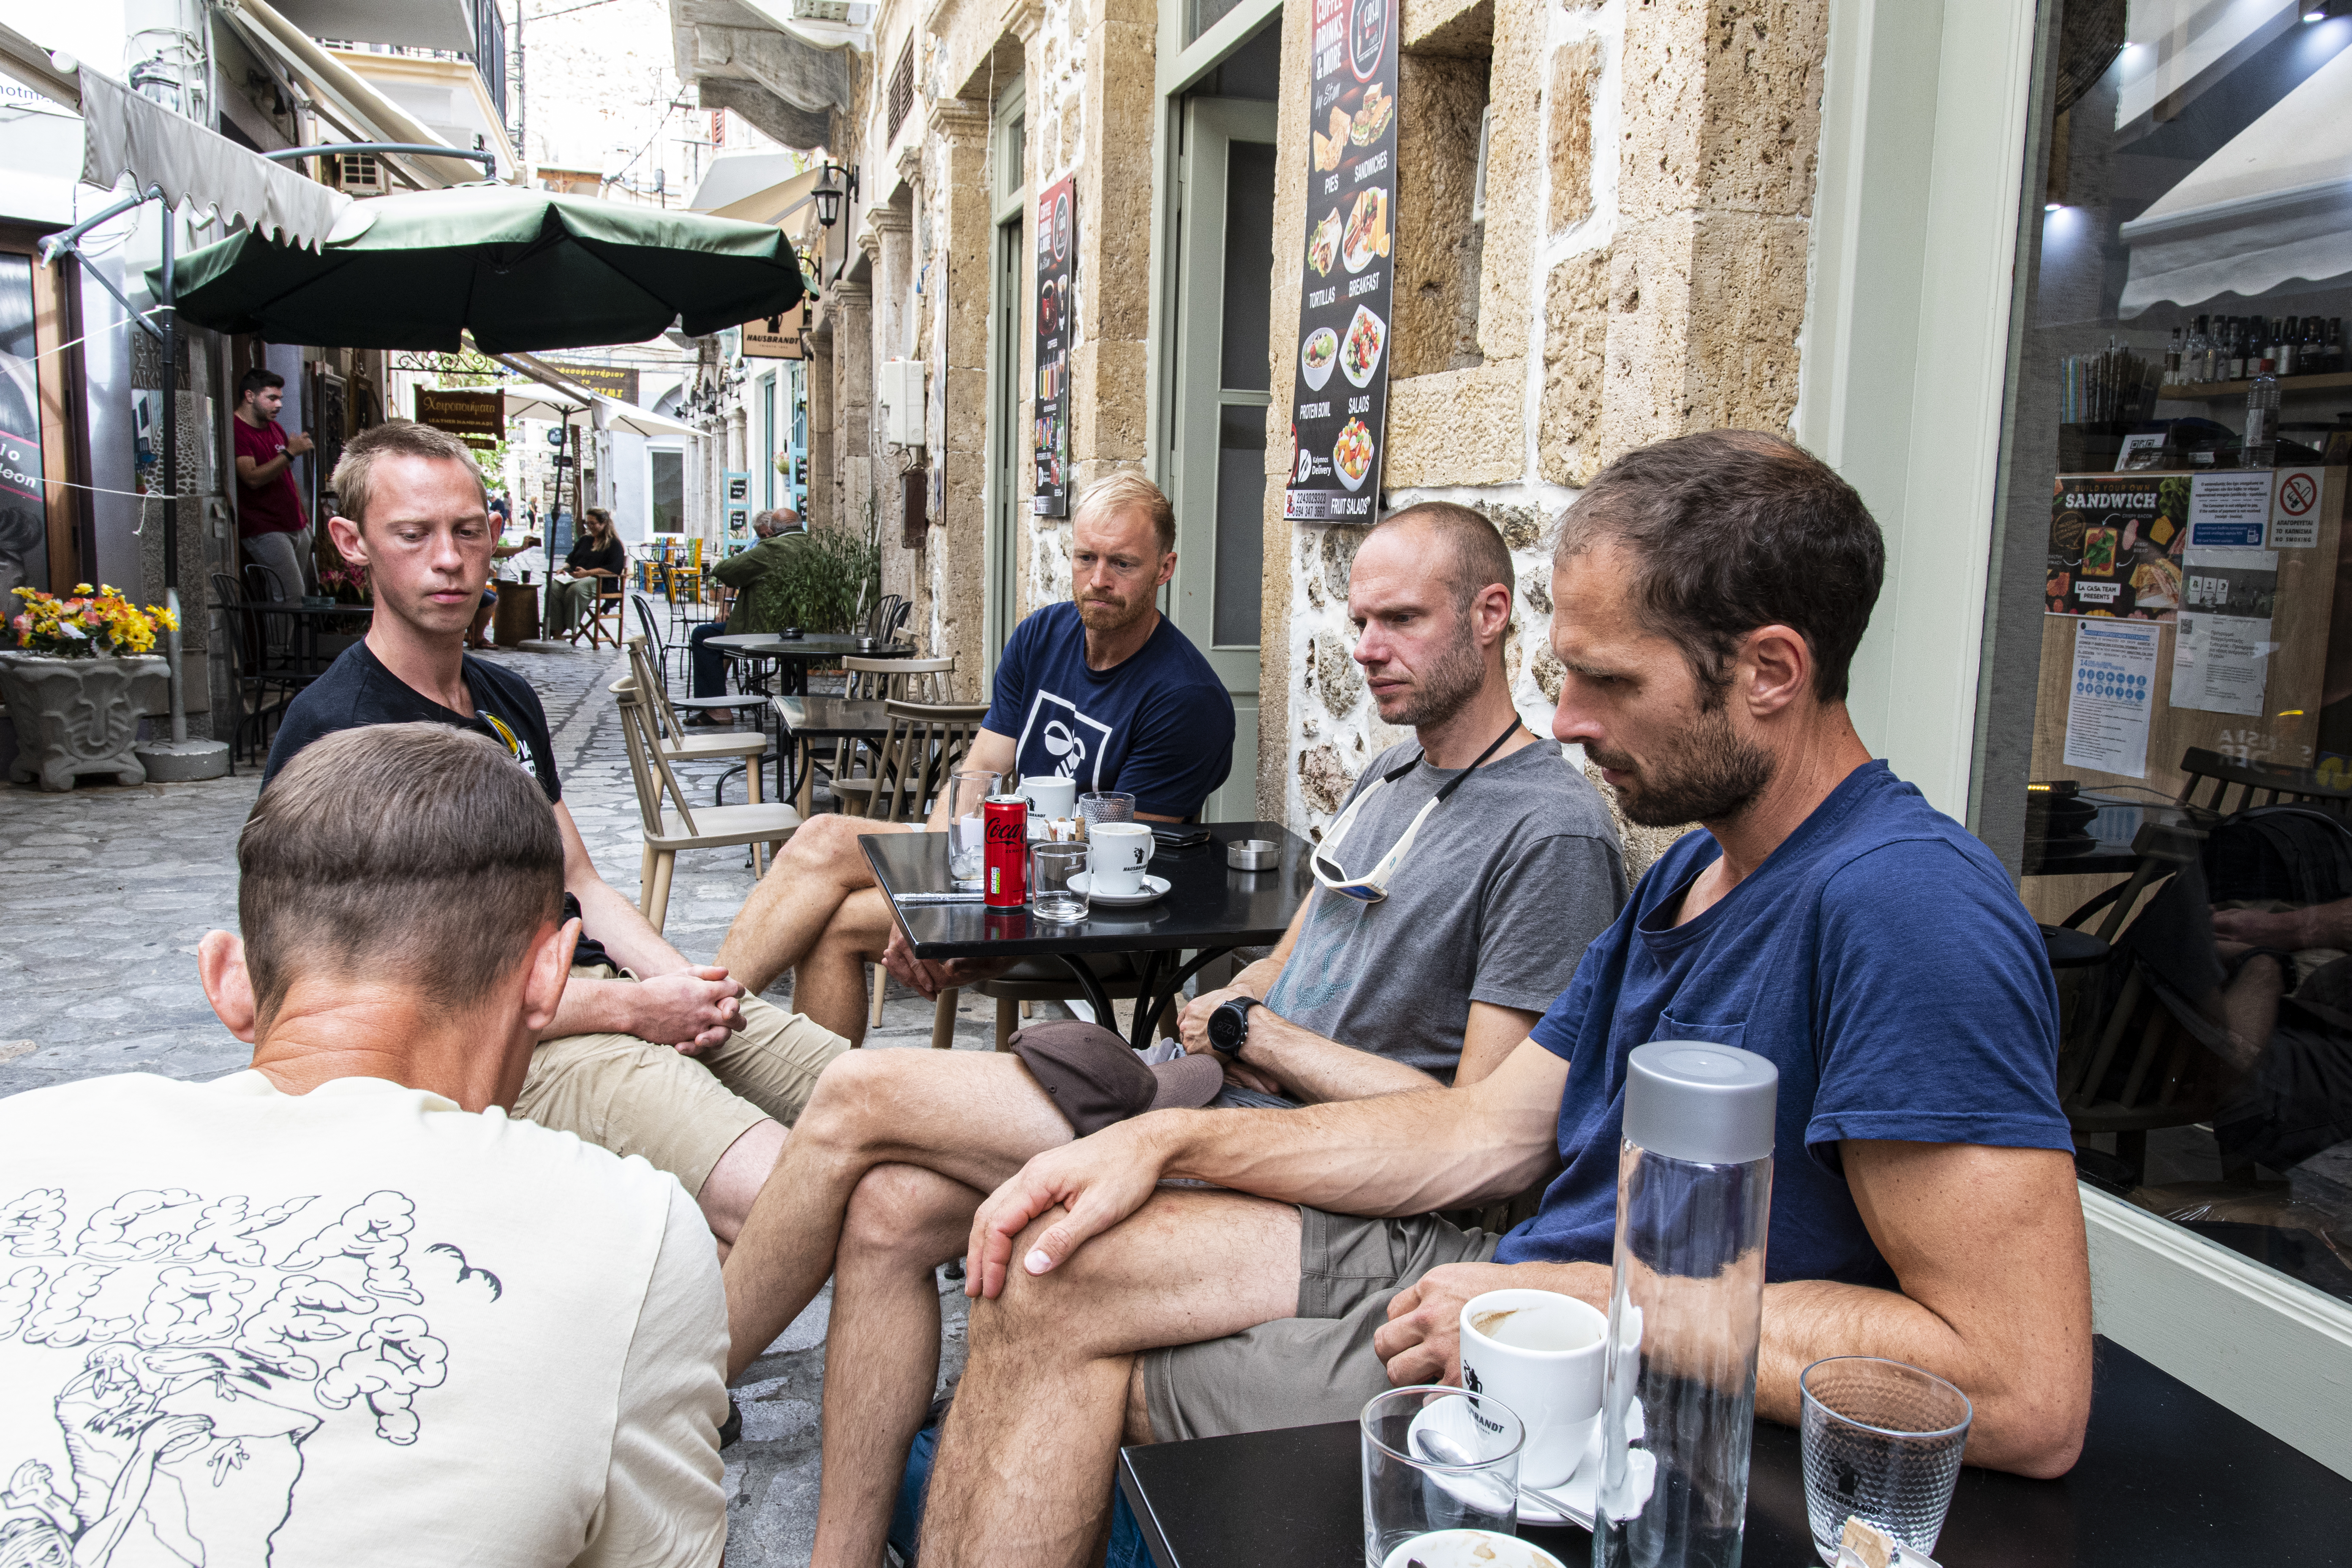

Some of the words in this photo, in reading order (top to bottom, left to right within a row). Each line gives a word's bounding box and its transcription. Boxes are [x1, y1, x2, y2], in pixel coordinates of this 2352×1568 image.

[1316, 12, 1343, 54] DRINKS
[1316, 56, 1323, 80] &
[1323, 41, 1342, 77] MORE
[1315, 90, 1323, 117] by
[1355, 150, 1387, 183] SANDWICHES
[1325, 173, 1339, 195] PIES
[1040, 200, 1051, 221] COFFEE
[1349, 272, 1380, 298] BREAKFAST
[1309, 286, 1335, 309] TORTILLAS
[747, 335, 800, 344] HAUSBRANDT
[1300, 403, 1318, 419] PROTEIN
[1318, 401, 1331, 418] BOWL
[1348, 395, 1369, 414] SALADS
[1312, 456, 1328, 465] Kalymnos
[1312, 465, 1331, 476] Delivery
[1296, 493, 1326, 504] 2243029323
[1331, 498, 1347, 514] FRUIT
[1346, 498, 1367, 515] SALADS
[2066, 493, 2157, 508] SANDWICH
[1295, 506, 1303, 517] 694
[1305, 506, 1313, 517] 347
[1314, 506, 1325, 517] 3663
[1816, 1483, 1882, 1515] HAUSBRANDT
